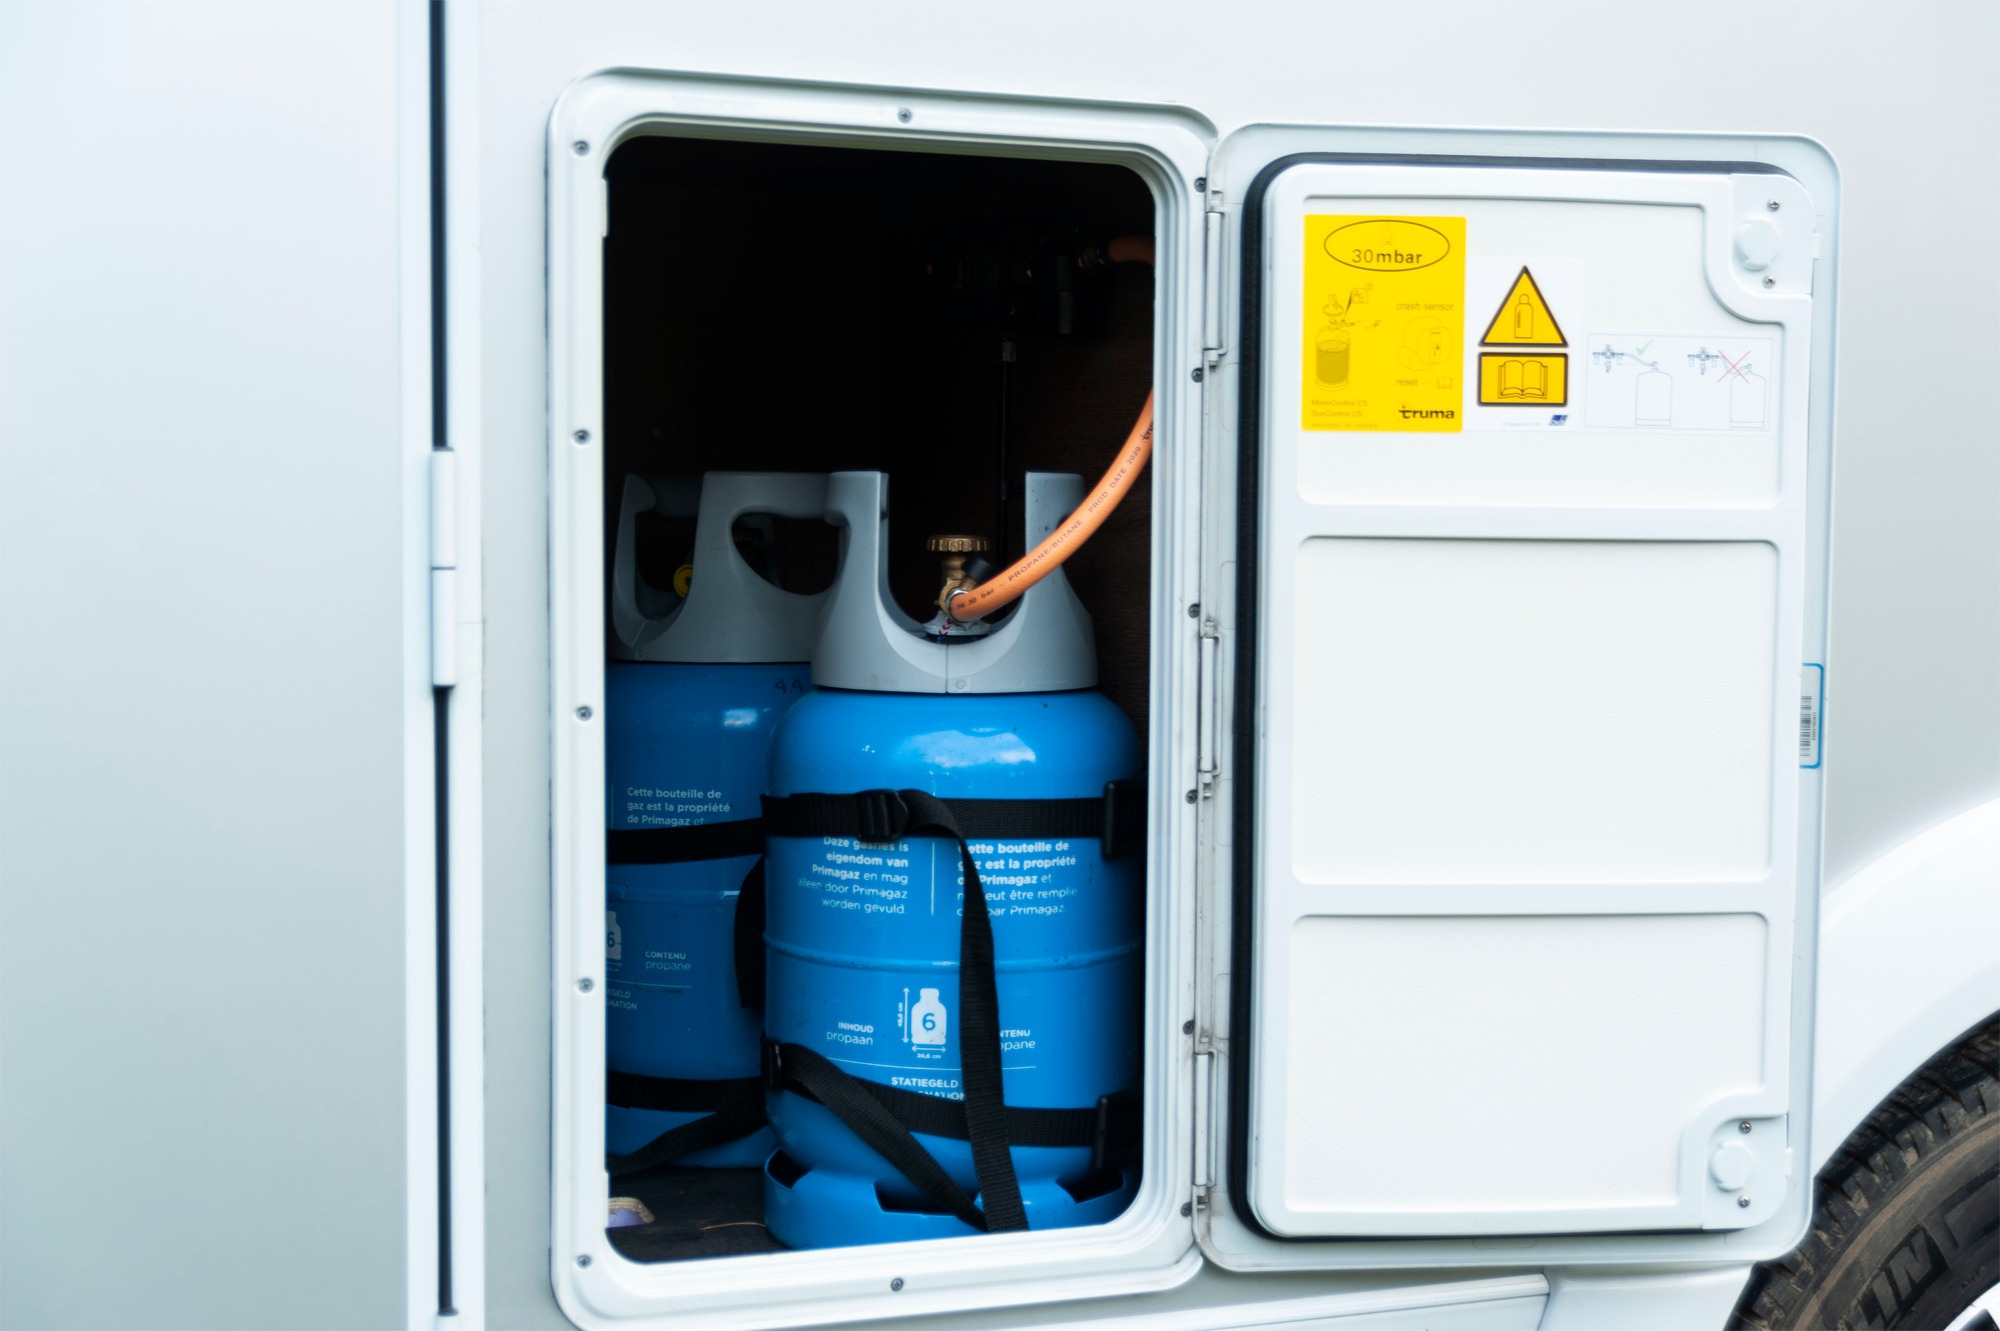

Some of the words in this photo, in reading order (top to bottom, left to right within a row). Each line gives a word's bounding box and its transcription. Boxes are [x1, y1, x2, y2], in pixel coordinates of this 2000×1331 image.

[1396, 302, 1421, 311] crash
[1423, 303, 1455, 311] sensor
[1395, 378, 1418, 386] reset
[1398, 405, 1455, 419] truma
[980, 588, 994, 598] bar
[1088, 491, 1108, 513] PROD
[1109, 467, 1127, 488] DATE
[1127, 446, 1141, 464] 2020
[627, 787, 653, 797] Cette
[656, 788, 704, 799] bouteille
[707, 789, 722, 799] de
[627, 802, 644, 811] gaz
[646, 803, 662, 811] est
[665, 802, 674, 812] la
[677, 802, 731, 814] propriété
[627, 815, 639, 824] de
[641, 815, 690, 827] Primagaz
[693, 817, 704, 825] et
[823, 836, 850, 848] Deze
[898, 841, 909, 852] is
[997, 842, 1052, 854] bouteille
[1055, 841, 1069, 851] de
[826, 851, 883, 866] eigendom
[887, 858, 909, 868] van
[985, 859, 1005, 870] est
[1009, 858, 1020, 869] la
[1023, 855, 1077, 870] propriété
[812, 864, 861, 880] Primagaz
[863, 873, 878, 881] en
[881, 873, 909, 886] mag
[979, 875, 1038, 886] Primagaz
[1041, 874, 1052, 883] et
[824, 882, 849, 894] door
[852, 884, 908, 900] Primagaz
[985, 891, 1005, 901] eut
[1010, 889, 1034, 900] être
[822, 898, 861, 910] worden
[607, 931, 616, 948] 6
[645, 951, 686, 960] CONTENU
[645, 961, 692, 971] propane
[838, 1021, 874, 1033] INHOUD
[922, 1012, 936, 1031] 6
[826, 1031, 874, 1046] propaan
[891, 1076, 959, 1088] STATIEGELD
